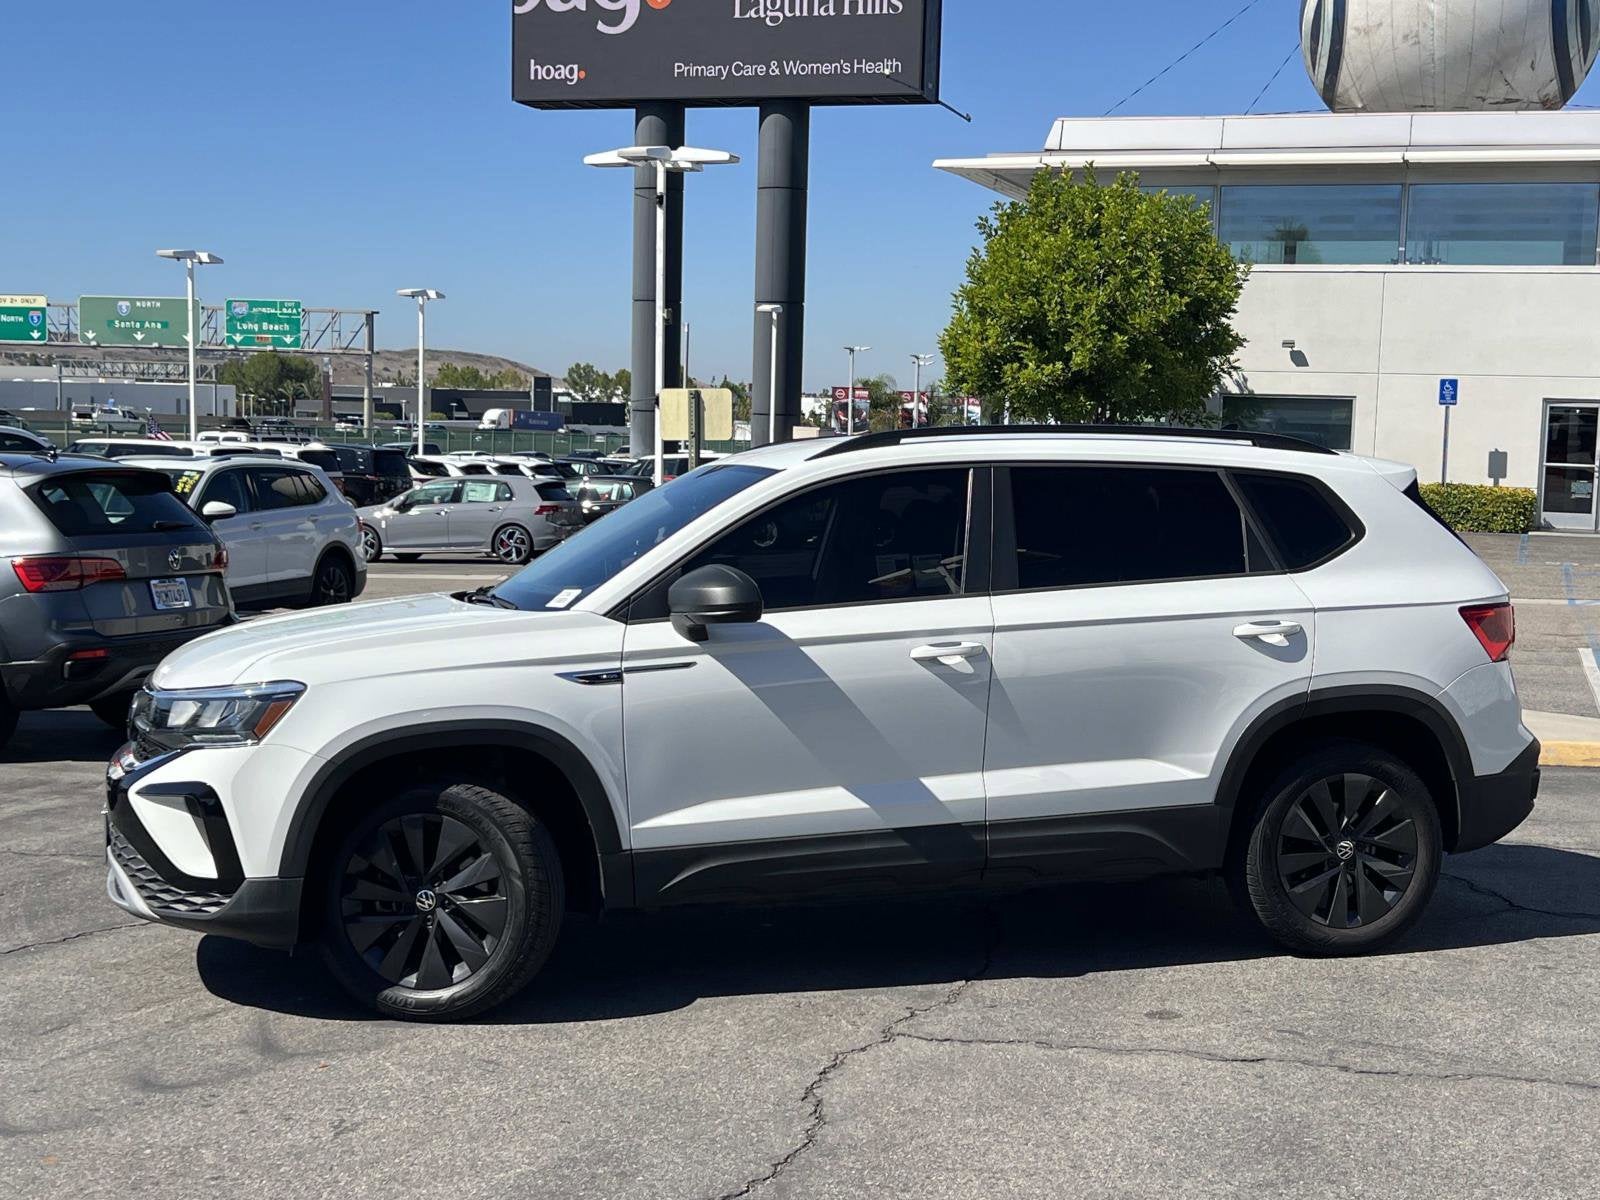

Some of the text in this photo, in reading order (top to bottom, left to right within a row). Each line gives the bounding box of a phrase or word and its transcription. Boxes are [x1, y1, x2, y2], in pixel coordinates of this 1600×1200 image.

[529, 59, 586, 85] hoag.
[674, 58, 902, 80] Primary Care & Women's Health
[113, 320, 162, 329] Santa Ana
[237, 321, 290, 332] Long Beach
